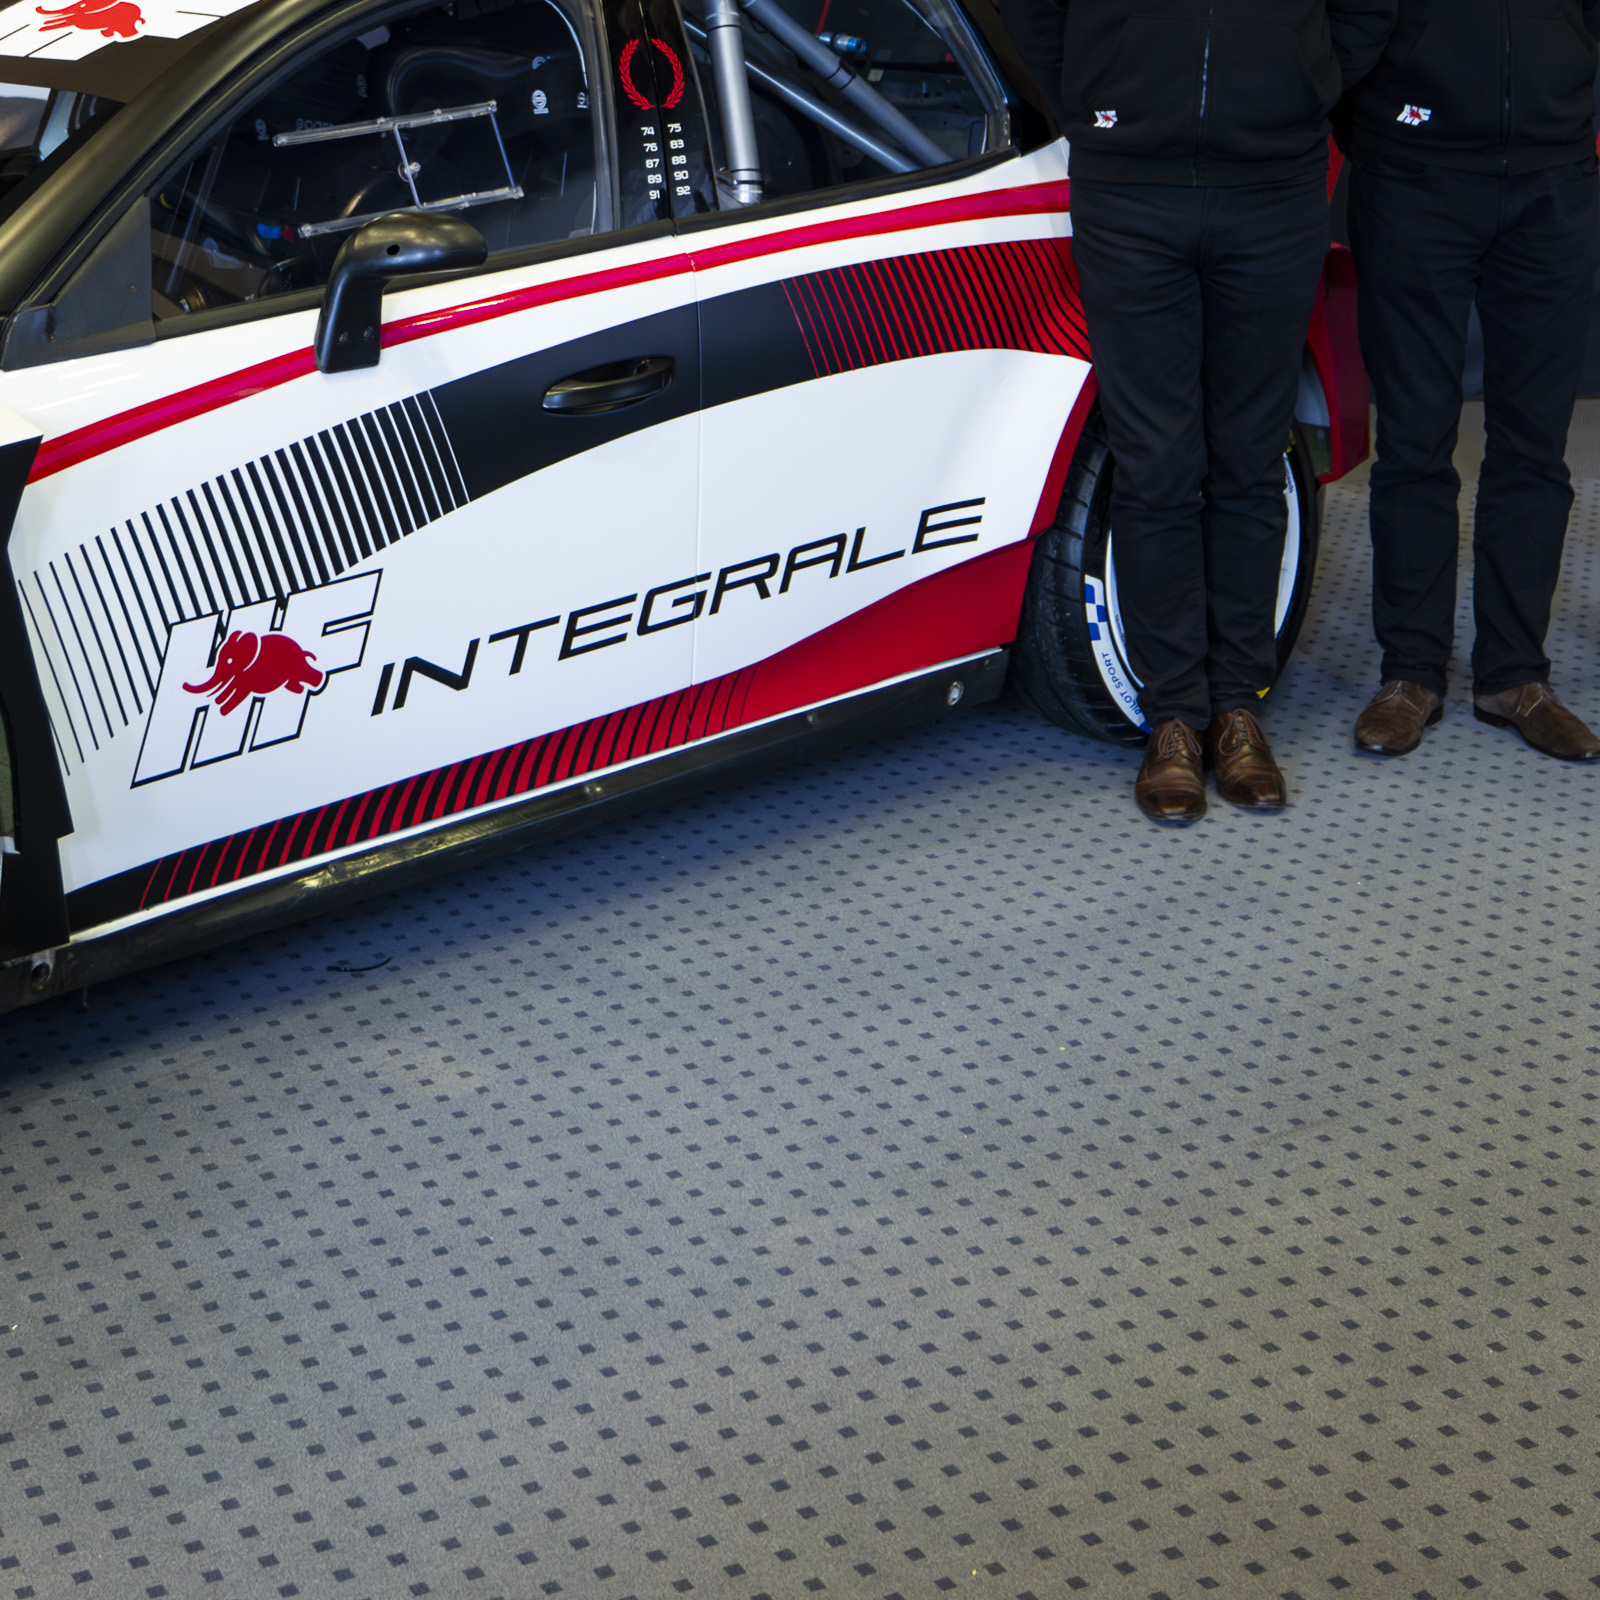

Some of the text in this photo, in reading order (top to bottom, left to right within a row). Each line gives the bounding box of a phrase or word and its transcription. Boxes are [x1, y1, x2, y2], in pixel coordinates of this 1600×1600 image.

[640, 123, 682, 136] 74 75
[643, 139, 685, 152] 76 83
[646, 155, 687, 169] 87 88
[647, 170, 689, 184] 89 90
[649, 185, 691, 199] 91 92
[370, 497, 986, 716] INTEGRALE
[1101, 652, 1123, 689] SPORT
